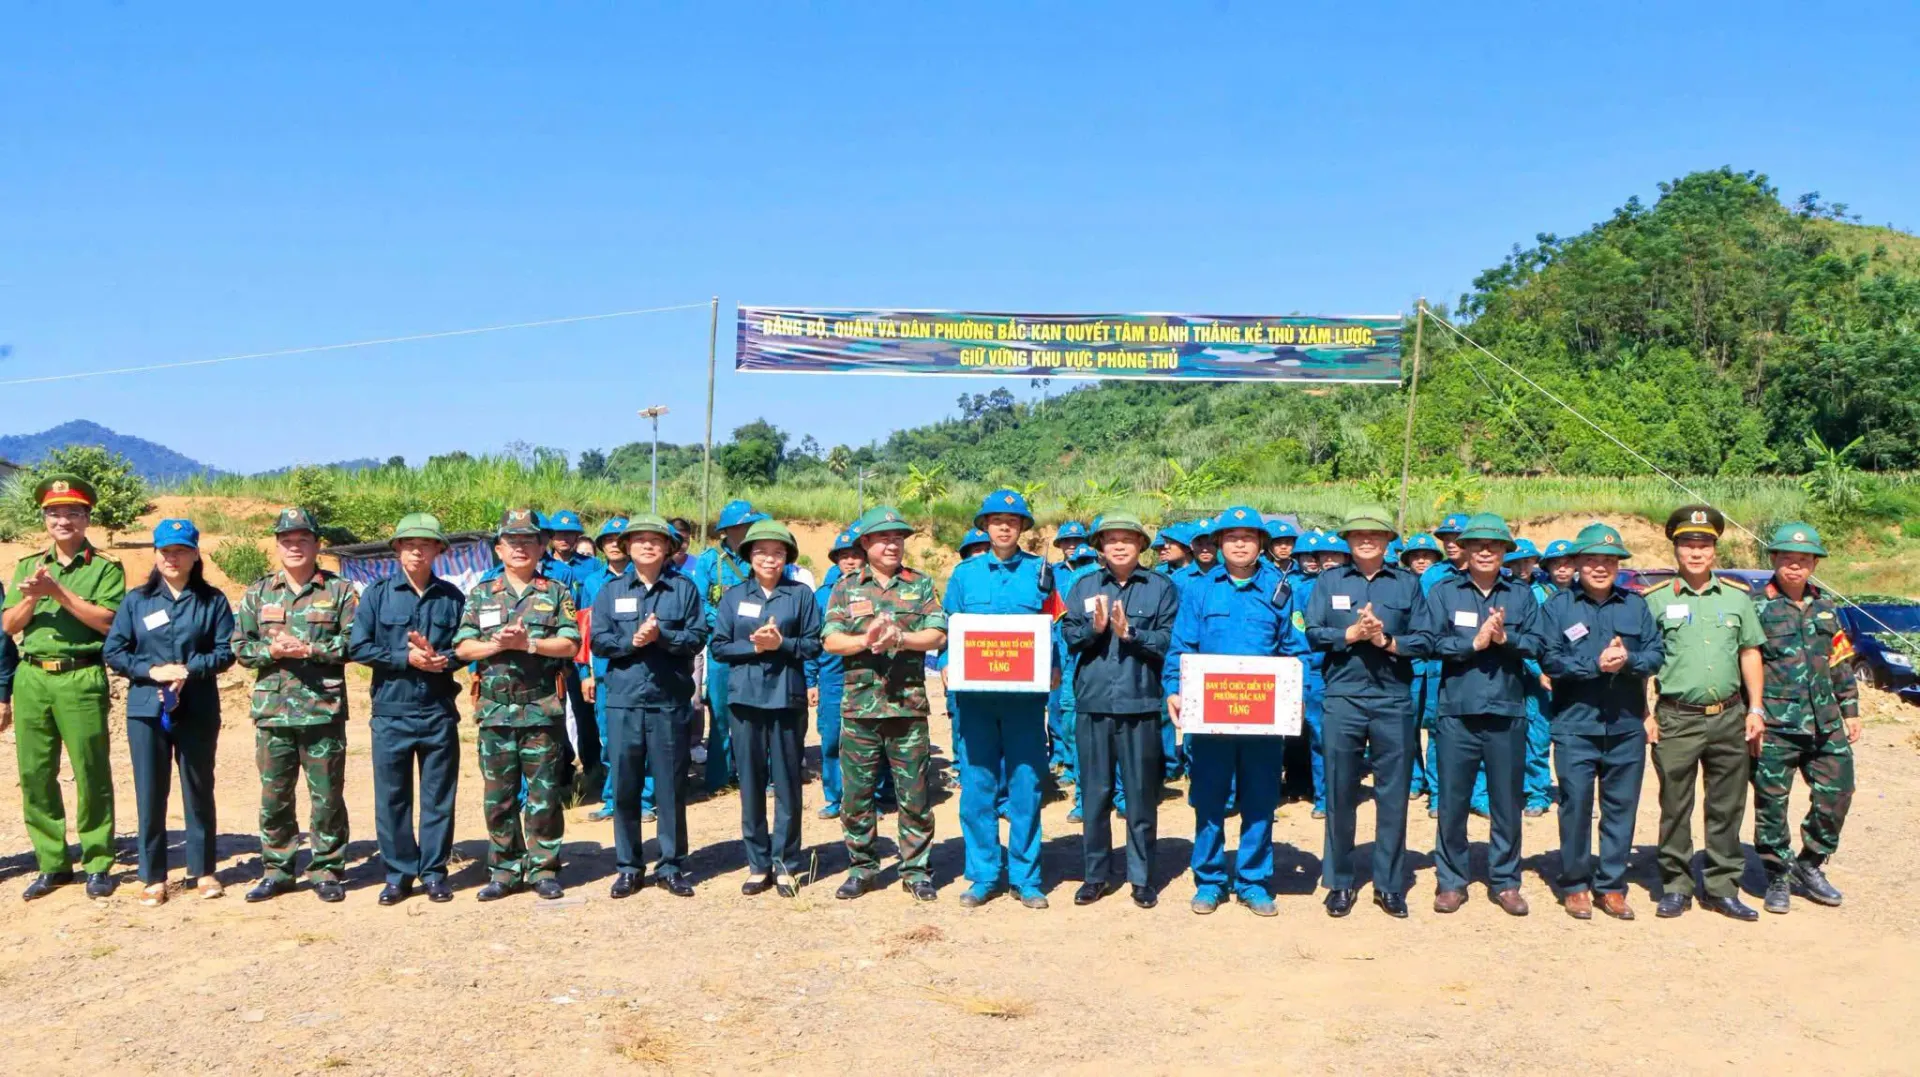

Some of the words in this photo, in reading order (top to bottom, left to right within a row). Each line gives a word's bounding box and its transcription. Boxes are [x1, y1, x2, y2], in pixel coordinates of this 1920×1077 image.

[763, 315, 802, 336] ĐẢNG
[806, 317, 830, 340] BỘ,
[834, 318, 874, 338] QUÂN
[878, 319, 896, 338] VÀ
[900, 319, 930, 338] DÂN
[934, 319, 994, 340] PHƯỜNG
[998, 318, 1026, 340] BẮC
[1031, 323, 1062, 344] KẠN
[1065, 320, 1110, 341] QUYẾT
[1114, 322, 1145, 342] TÂM
[1149, 323, 1189, 342] ĐÁNH
[1193, 320, 1241, 343] THẮNG
[1244, 321, 1263, 344] KẺ
[1267, 324, 1294, 344] THÙ
[1298, 324, 1331, 344] XÂM
[1335, 326, 1376, 348] LƯỢC,
[959, 346, 987, 366] GIỮ
[988, 347, 1028, 367] VỮNG
[1031, 350, 1061, 368] KHU
[1064, 349, 1093, 371] VỰC
[1097, 348, 1147, 369] PHÒNG
[1151, 348, 1179, 369] THỦ
[988, 660, 1010, 672] TẶNG
[1228, 702, 1250, 716] TẶNG
